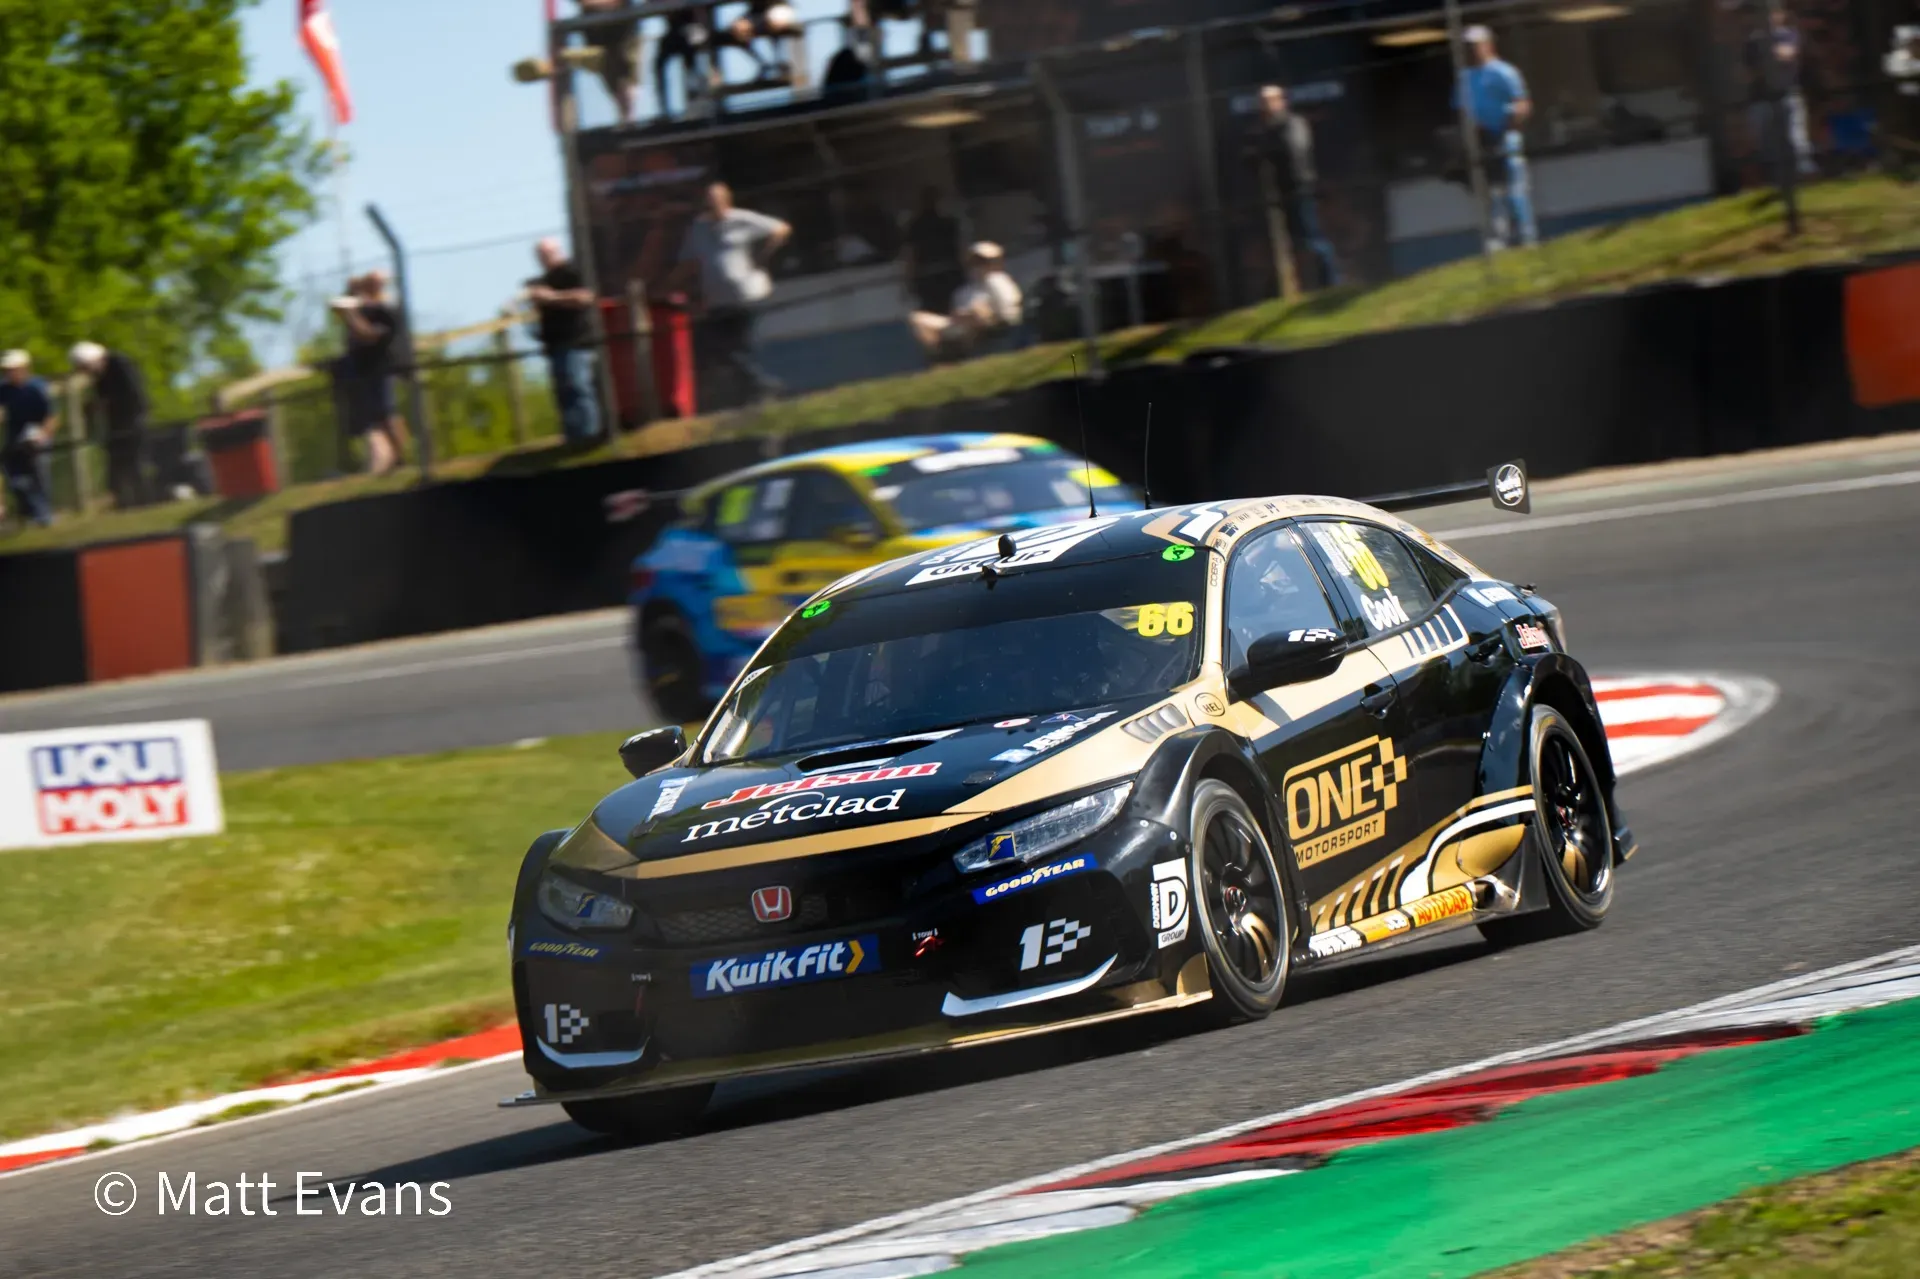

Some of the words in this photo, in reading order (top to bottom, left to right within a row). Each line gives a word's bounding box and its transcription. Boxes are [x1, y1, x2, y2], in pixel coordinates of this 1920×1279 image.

[1138, 601, 1194, 637] 66
[1361, 588, 1411, 631] Cook
[1202, 702, 1221, 713] HEL
[36, 739, 178, 788] LIQUI
[44, 782, 187, 832] MOLY
[681, 788, 906, 843] metclad
[1286, 753, 1378, 840] ONE
[1295, 819, 1378, 864] MOTORSPORT
[985, 858, 1085, 898] GOODYEAR
[1413, 889, 1468, 924] AUTOCAR
[528, 941, 600, 958] GOODYEAR
[1161, 929, 1185, 943] GROUP
